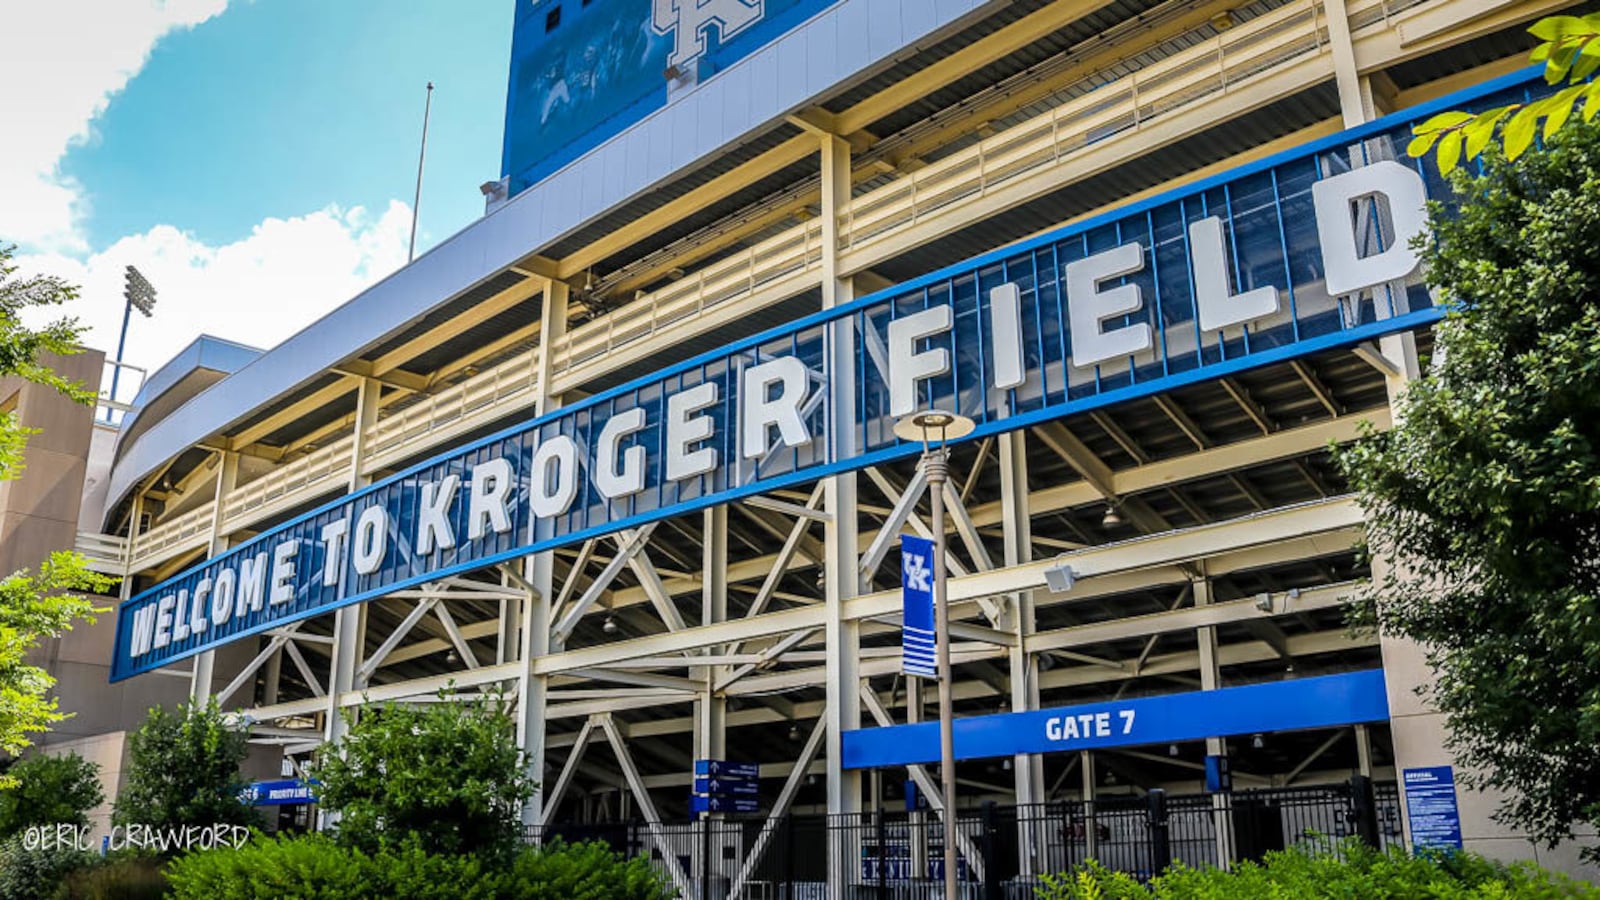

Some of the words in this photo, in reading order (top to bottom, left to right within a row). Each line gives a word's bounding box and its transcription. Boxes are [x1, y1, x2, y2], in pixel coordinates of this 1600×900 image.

[130, 540, 299, 657] WELCOME
[322, 504, 389, 587] TO
[416, 355, 812, 556] KROGER
[888, 160, 1429, 417] FIELD
[902, 551, 930, 592] UK
[1046, 712, 1111, 741] GATE
[1119, 709, 1136, 734] 7
